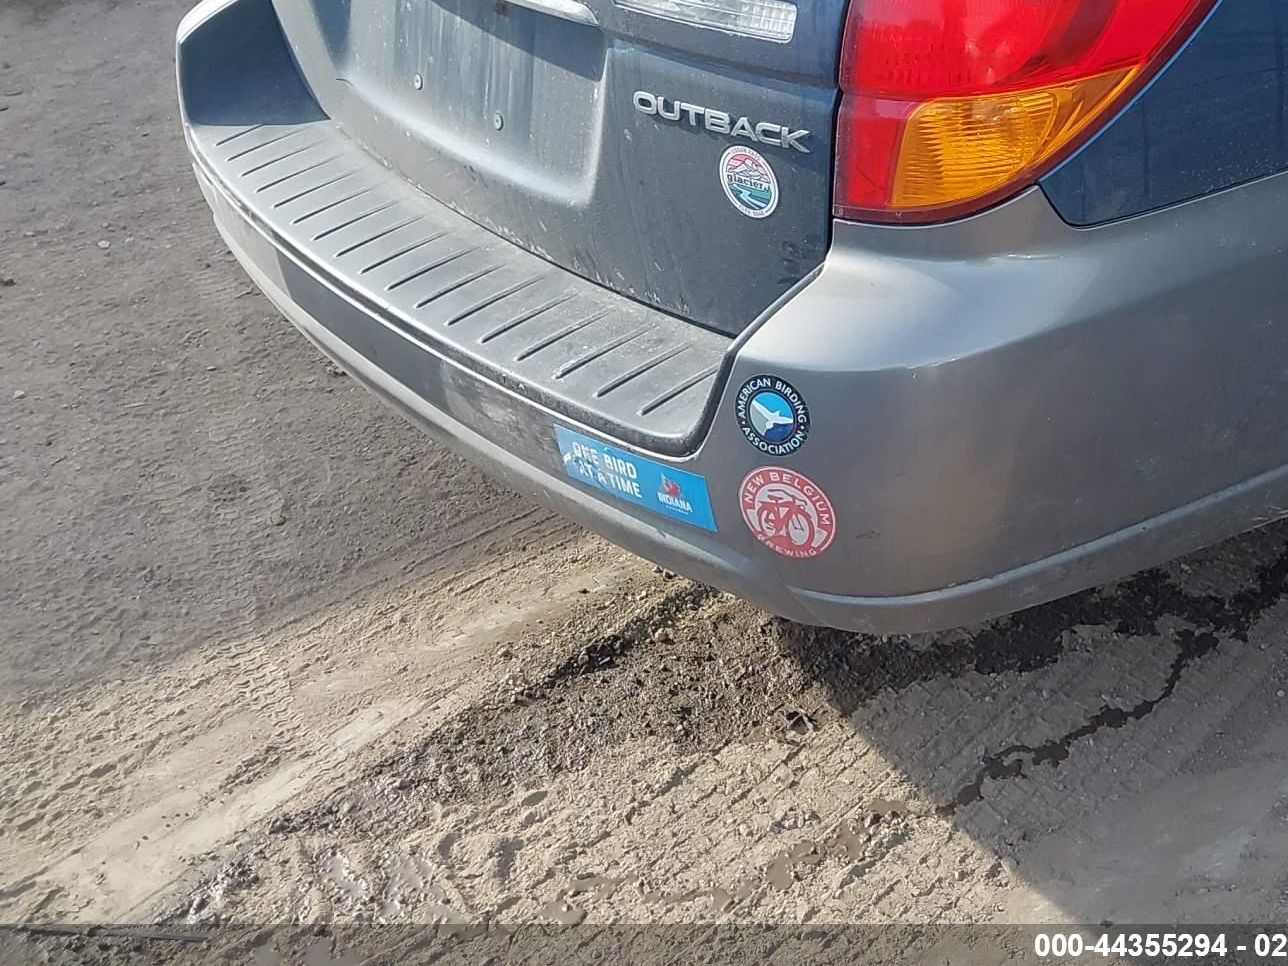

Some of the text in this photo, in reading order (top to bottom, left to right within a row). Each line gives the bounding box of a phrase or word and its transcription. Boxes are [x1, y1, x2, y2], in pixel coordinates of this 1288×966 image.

[632, 90, 811, 154] OUTBACK
[727, 172, 763, 189] glacier
[737, 377, 807, 424] AMERICAN BIRDING
[742, 426, 806, 456] ASSOCIATION
[572, 441, 638, 480] ONE BIRD
[607, 472, 643, 499] TIME
[657, 491, 693, 513] INDIANA
[744, 471, 832, 526] NEW BELGIUM
